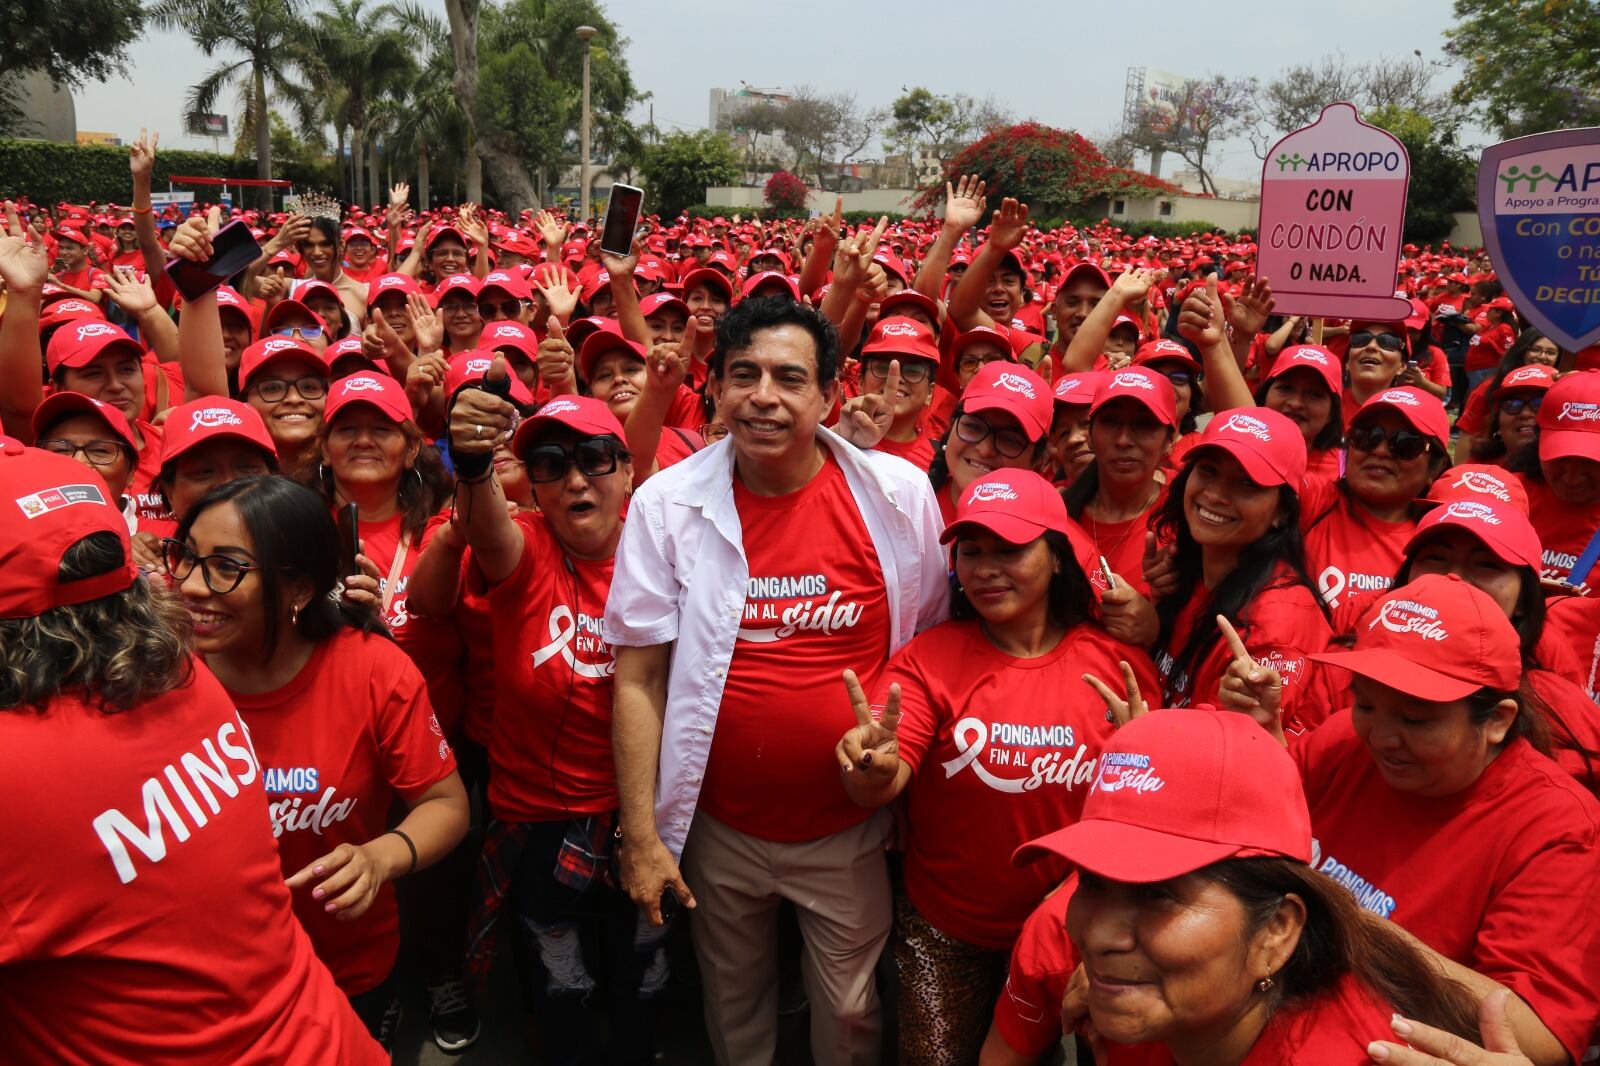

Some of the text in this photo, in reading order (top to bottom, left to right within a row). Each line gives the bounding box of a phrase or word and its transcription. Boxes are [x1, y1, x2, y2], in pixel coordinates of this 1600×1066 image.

[1307, 152, 1399, 172] APROPO
[1306, 188, 1353, 211] CON
[1505, 197, 1544, 209] Apoyo
[1271, 216, 1386, 252] CONDÓN
[1516, 218, 1560, 236] Con
[1558, 245, 1572, 259] o
[1290, 262, 1366, 283] O NADA.
[747, 575, 826, 598] ONGAMOS
[1348, 572, 1395, 591] PONGA
[745, 603, 778, 619] IN AL
[776, 590, 864, 638] sida
[1394, 600, 1438, 619] PONGAMOS
[1400, 616, 1449, 640] sida
[990, 722, 1074, 746] PONGAMOS
[990, 748, 1028, 767] FIN AL
[1022, 743, 1097, 791] sida
[264, 767, 319, 793] AMOS
[1114, 767, 1165, 794] sida
[269, 786, 357, 838] sida
